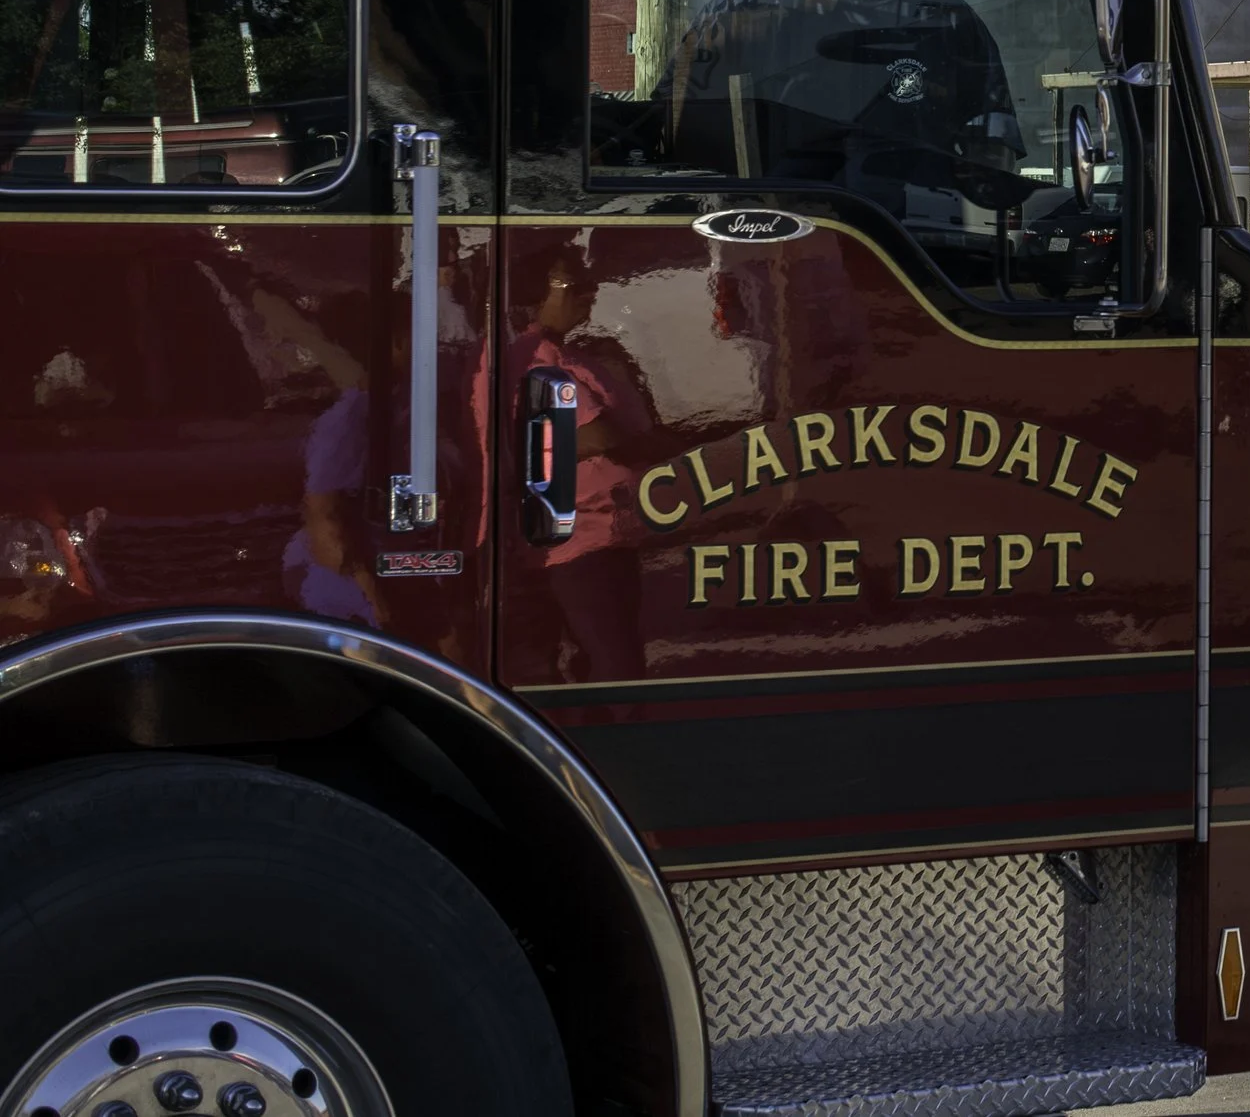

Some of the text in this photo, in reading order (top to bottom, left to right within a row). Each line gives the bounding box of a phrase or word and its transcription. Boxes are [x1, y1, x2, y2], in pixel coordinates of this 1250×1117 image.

[886, 59, 927, 72] CLARKSDALE
[728, 214, 781, 238] Impel
[638, 404, 1138, 525] CLARKSDALE
[383, 553, 457, 569] TAK-4
[690, 531, 1095, 603] FIRE DEPT.
